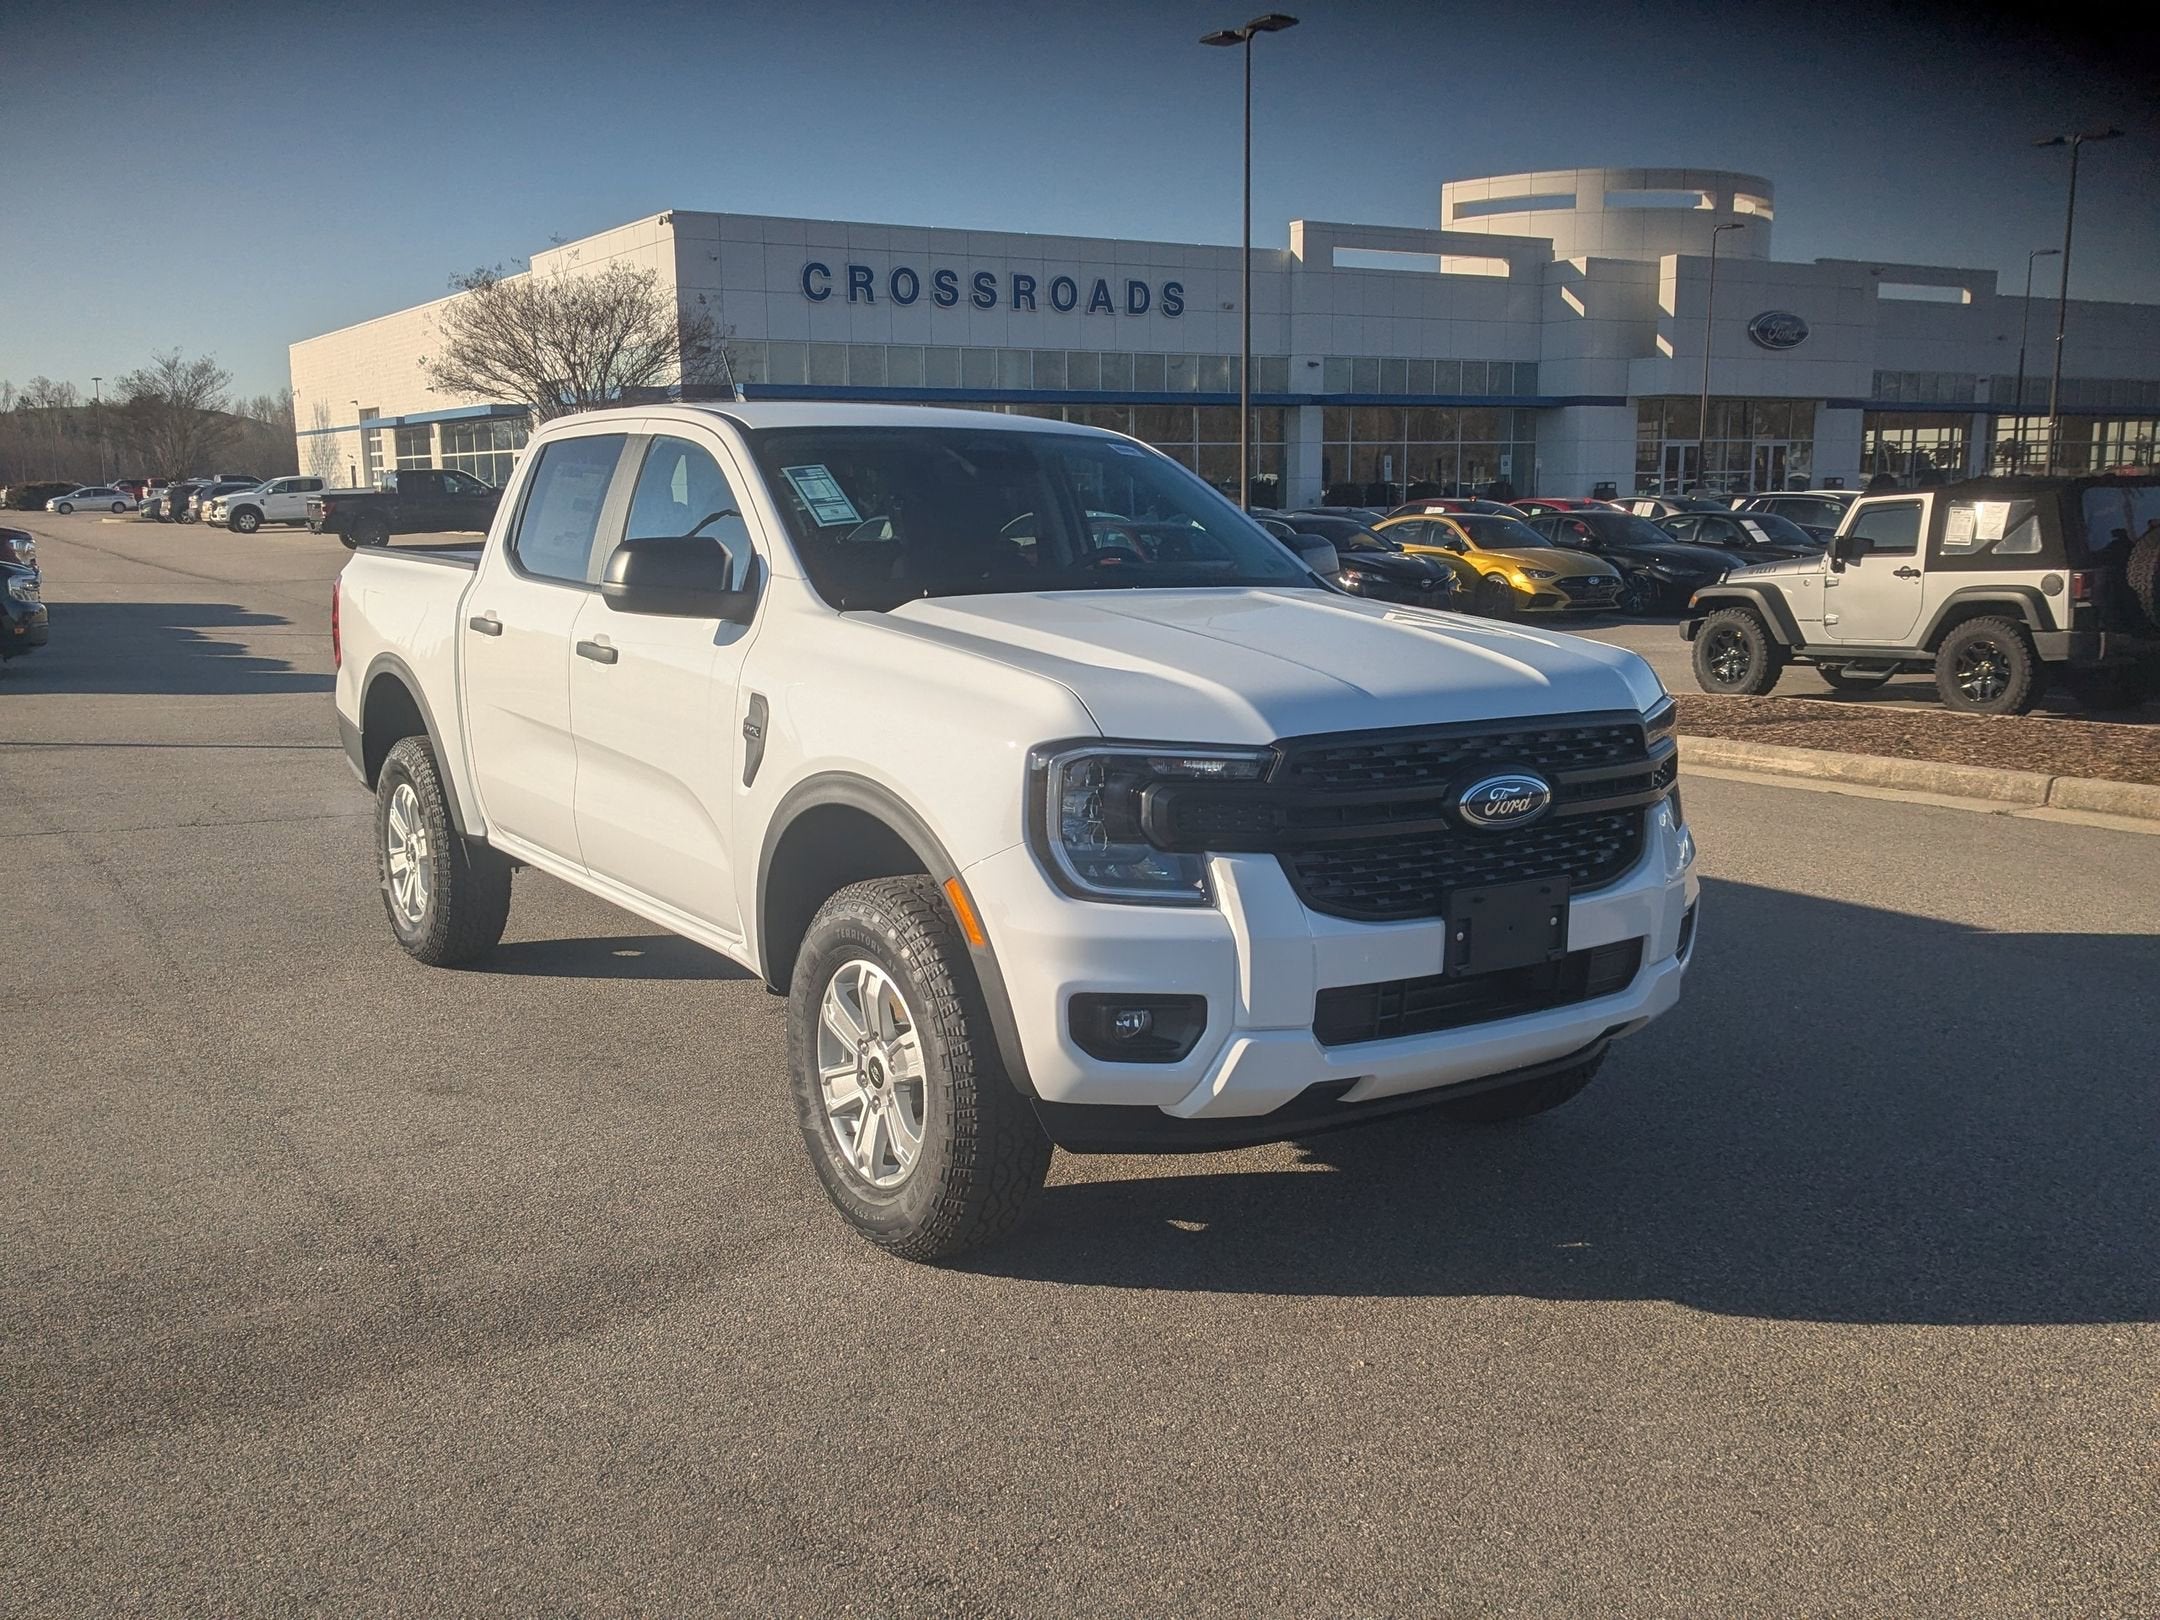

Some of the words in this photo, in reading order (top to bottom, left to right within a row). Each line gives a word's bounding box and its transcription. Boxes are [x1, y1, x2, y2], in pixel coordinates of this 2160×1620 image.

[801, 261, 1186, 318] CROSSROADS
[1484, 786, 1533, 816] Ford
[835, 927, 882, 954] TERRITORY
